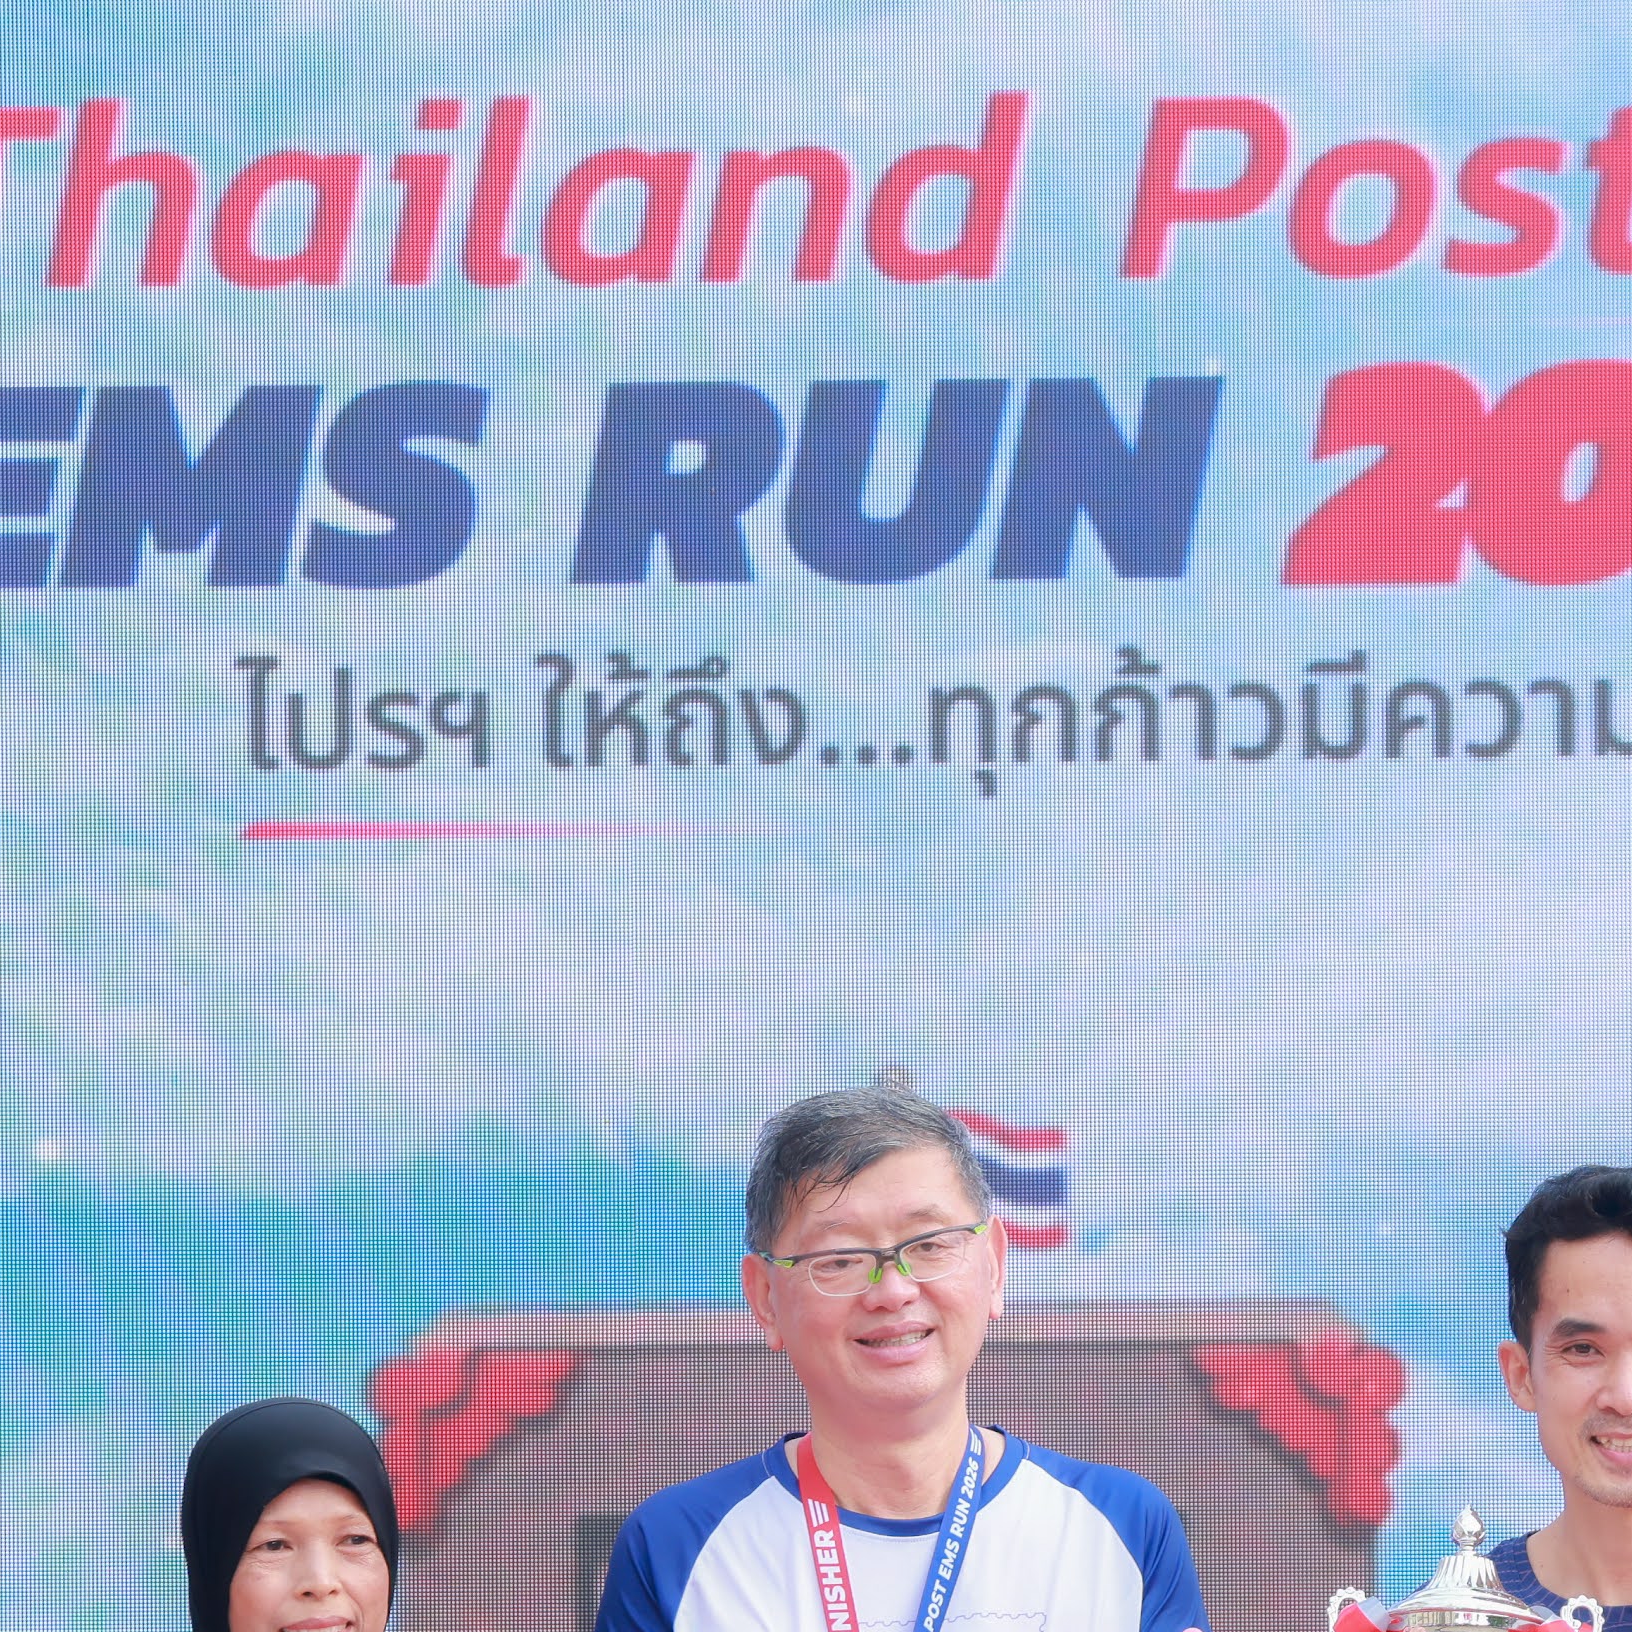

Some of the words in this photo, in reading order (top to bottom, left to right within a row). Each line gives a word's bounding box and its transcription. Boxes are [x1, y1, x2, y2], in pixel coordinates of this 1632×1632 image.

[569, 375, 1224, 586] RUN
[235, 652, 492, 772] ไปรฯ
[924, 1579, 947, 1632] POST
[938, 1538, 960, 1580] EMS
[950, 1497, 971, 1538] RUN
[961, 1456, 979, 1499] 2026
